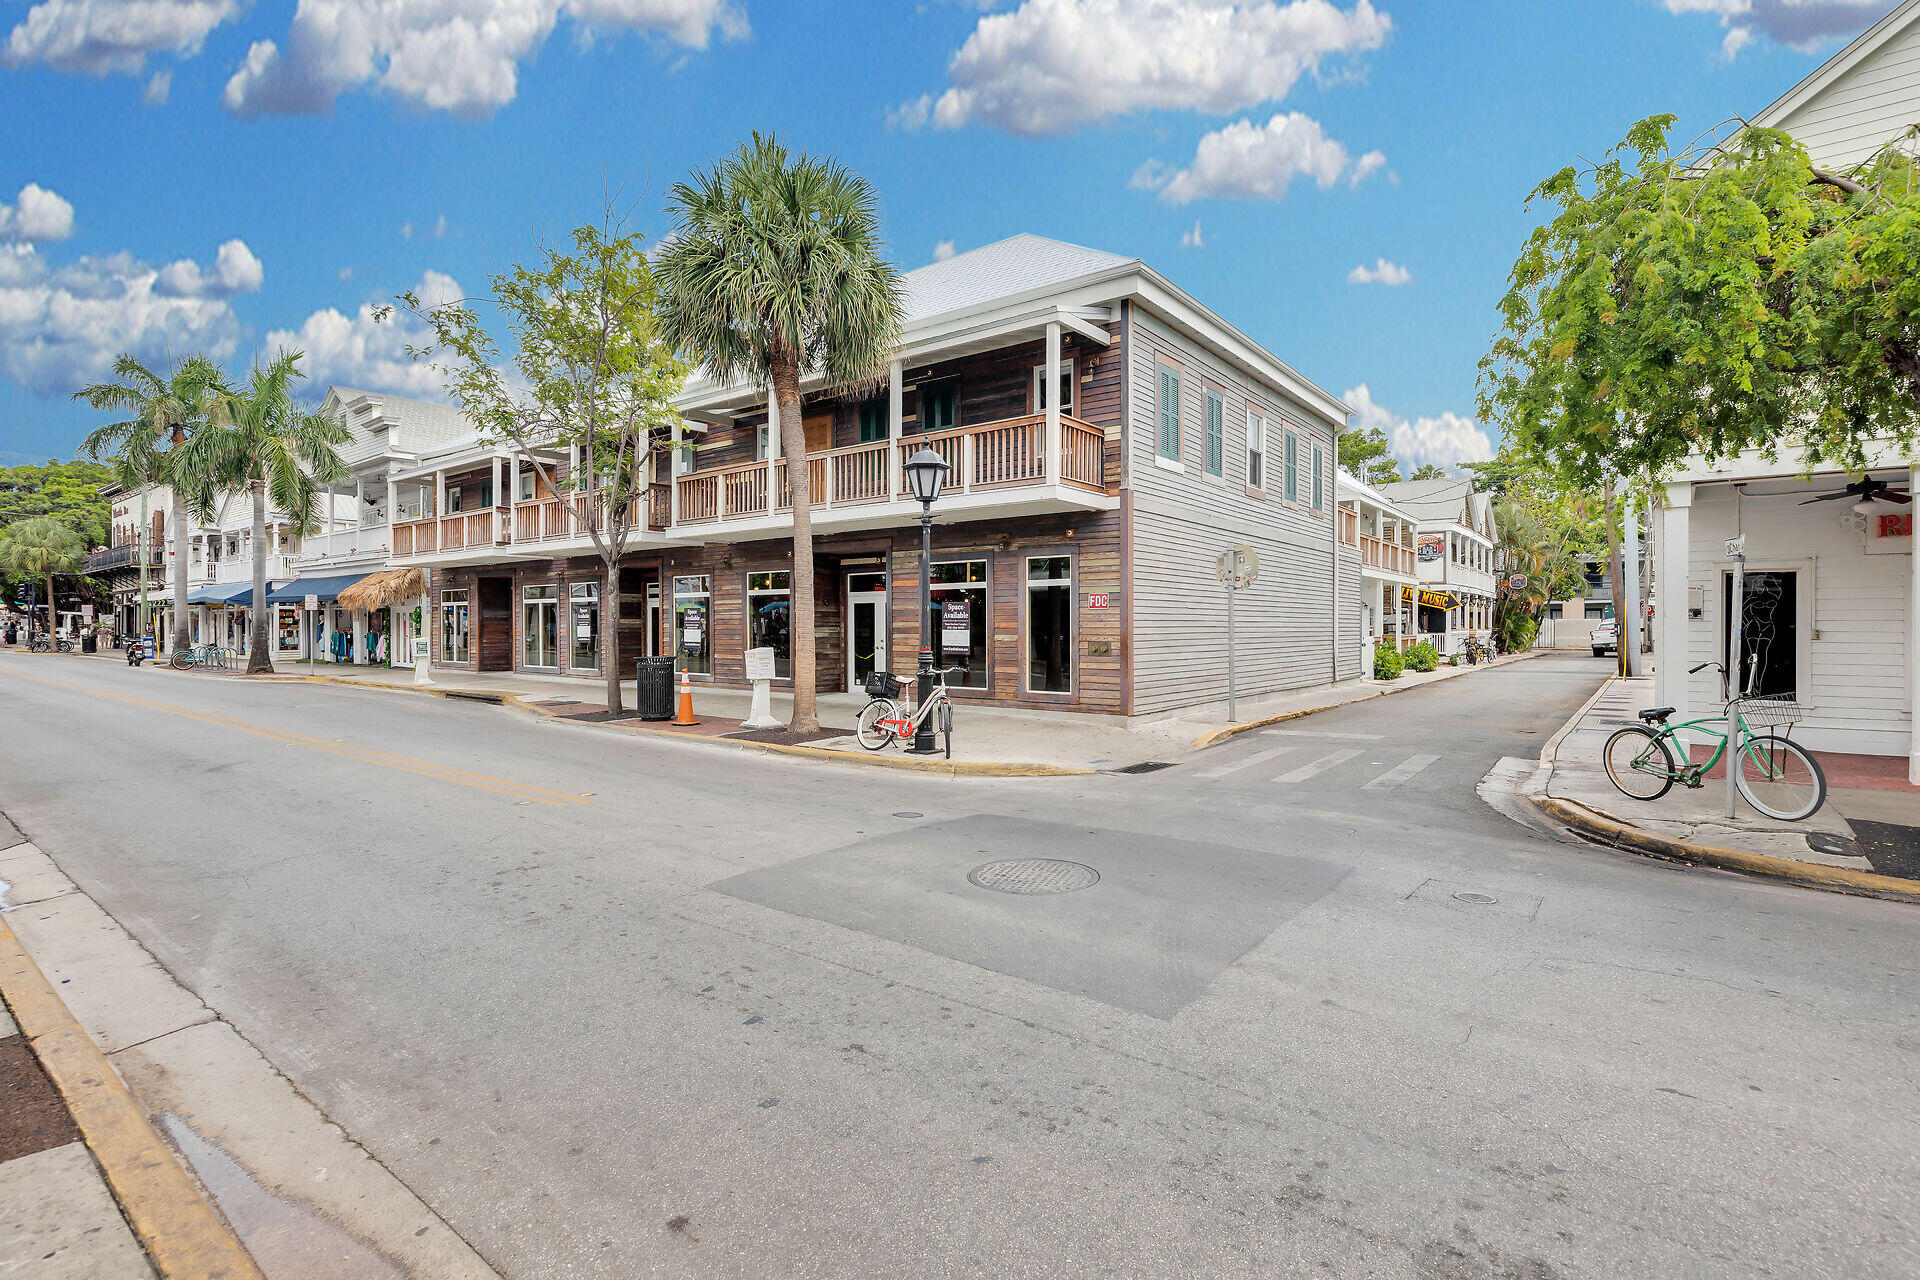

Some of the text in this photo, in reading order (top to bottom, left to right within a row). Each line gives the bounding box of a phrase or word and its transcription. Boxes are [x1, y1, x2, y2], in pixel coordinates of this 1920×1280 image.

[1090, 595, 1107, 607] FDC
[1421, 591, 1449, 607] MUSIC
[947, 603, 964, 612] Space
[943, 611, 969, 619] Available
